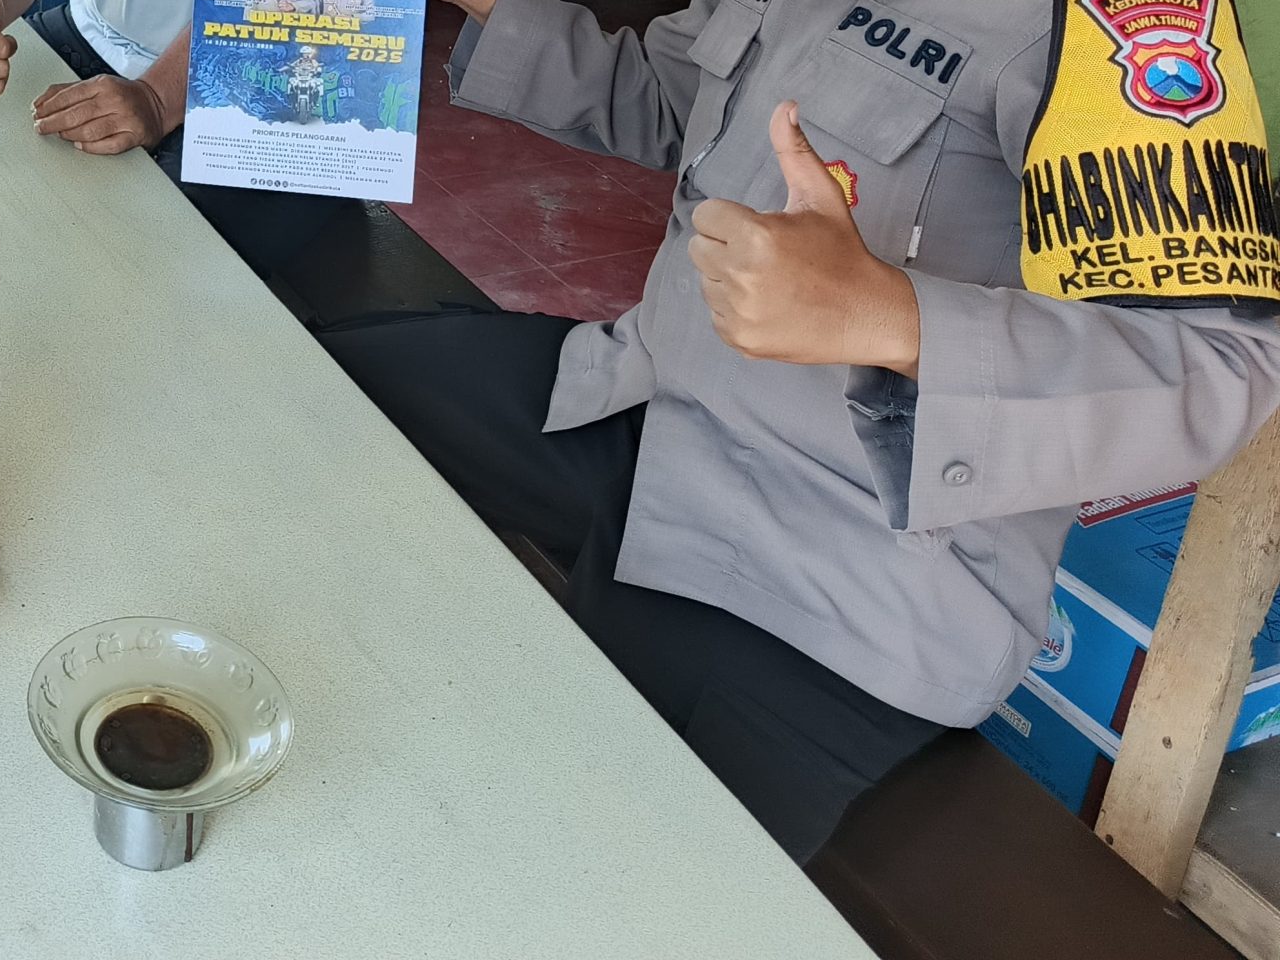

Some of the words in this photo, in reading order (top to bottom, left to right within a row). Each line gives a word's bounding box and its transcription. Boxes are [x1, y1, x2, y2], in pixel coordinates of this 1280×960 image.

[249, 9, 361, 31] OPERASI
[1124, 15, 1160, 34] JAWA
[1159, 15, 1198, 31] TIMUR
[203, 21, 290, 42] PATUH
[294, 28, 405, 50] SEMERU
[837, 6, 963, 84] POLRI
[346, 47, 403, 64] 2025
[252, 128, 290, 139] PRIORITAS
[291, 132, 347, 143] PELANGGARAN
[1070, 241, 1156, 270] KEL.
[1059, 268, 1146, 295] KEC.
[1150, 261, 1280, 291] PESANTR
